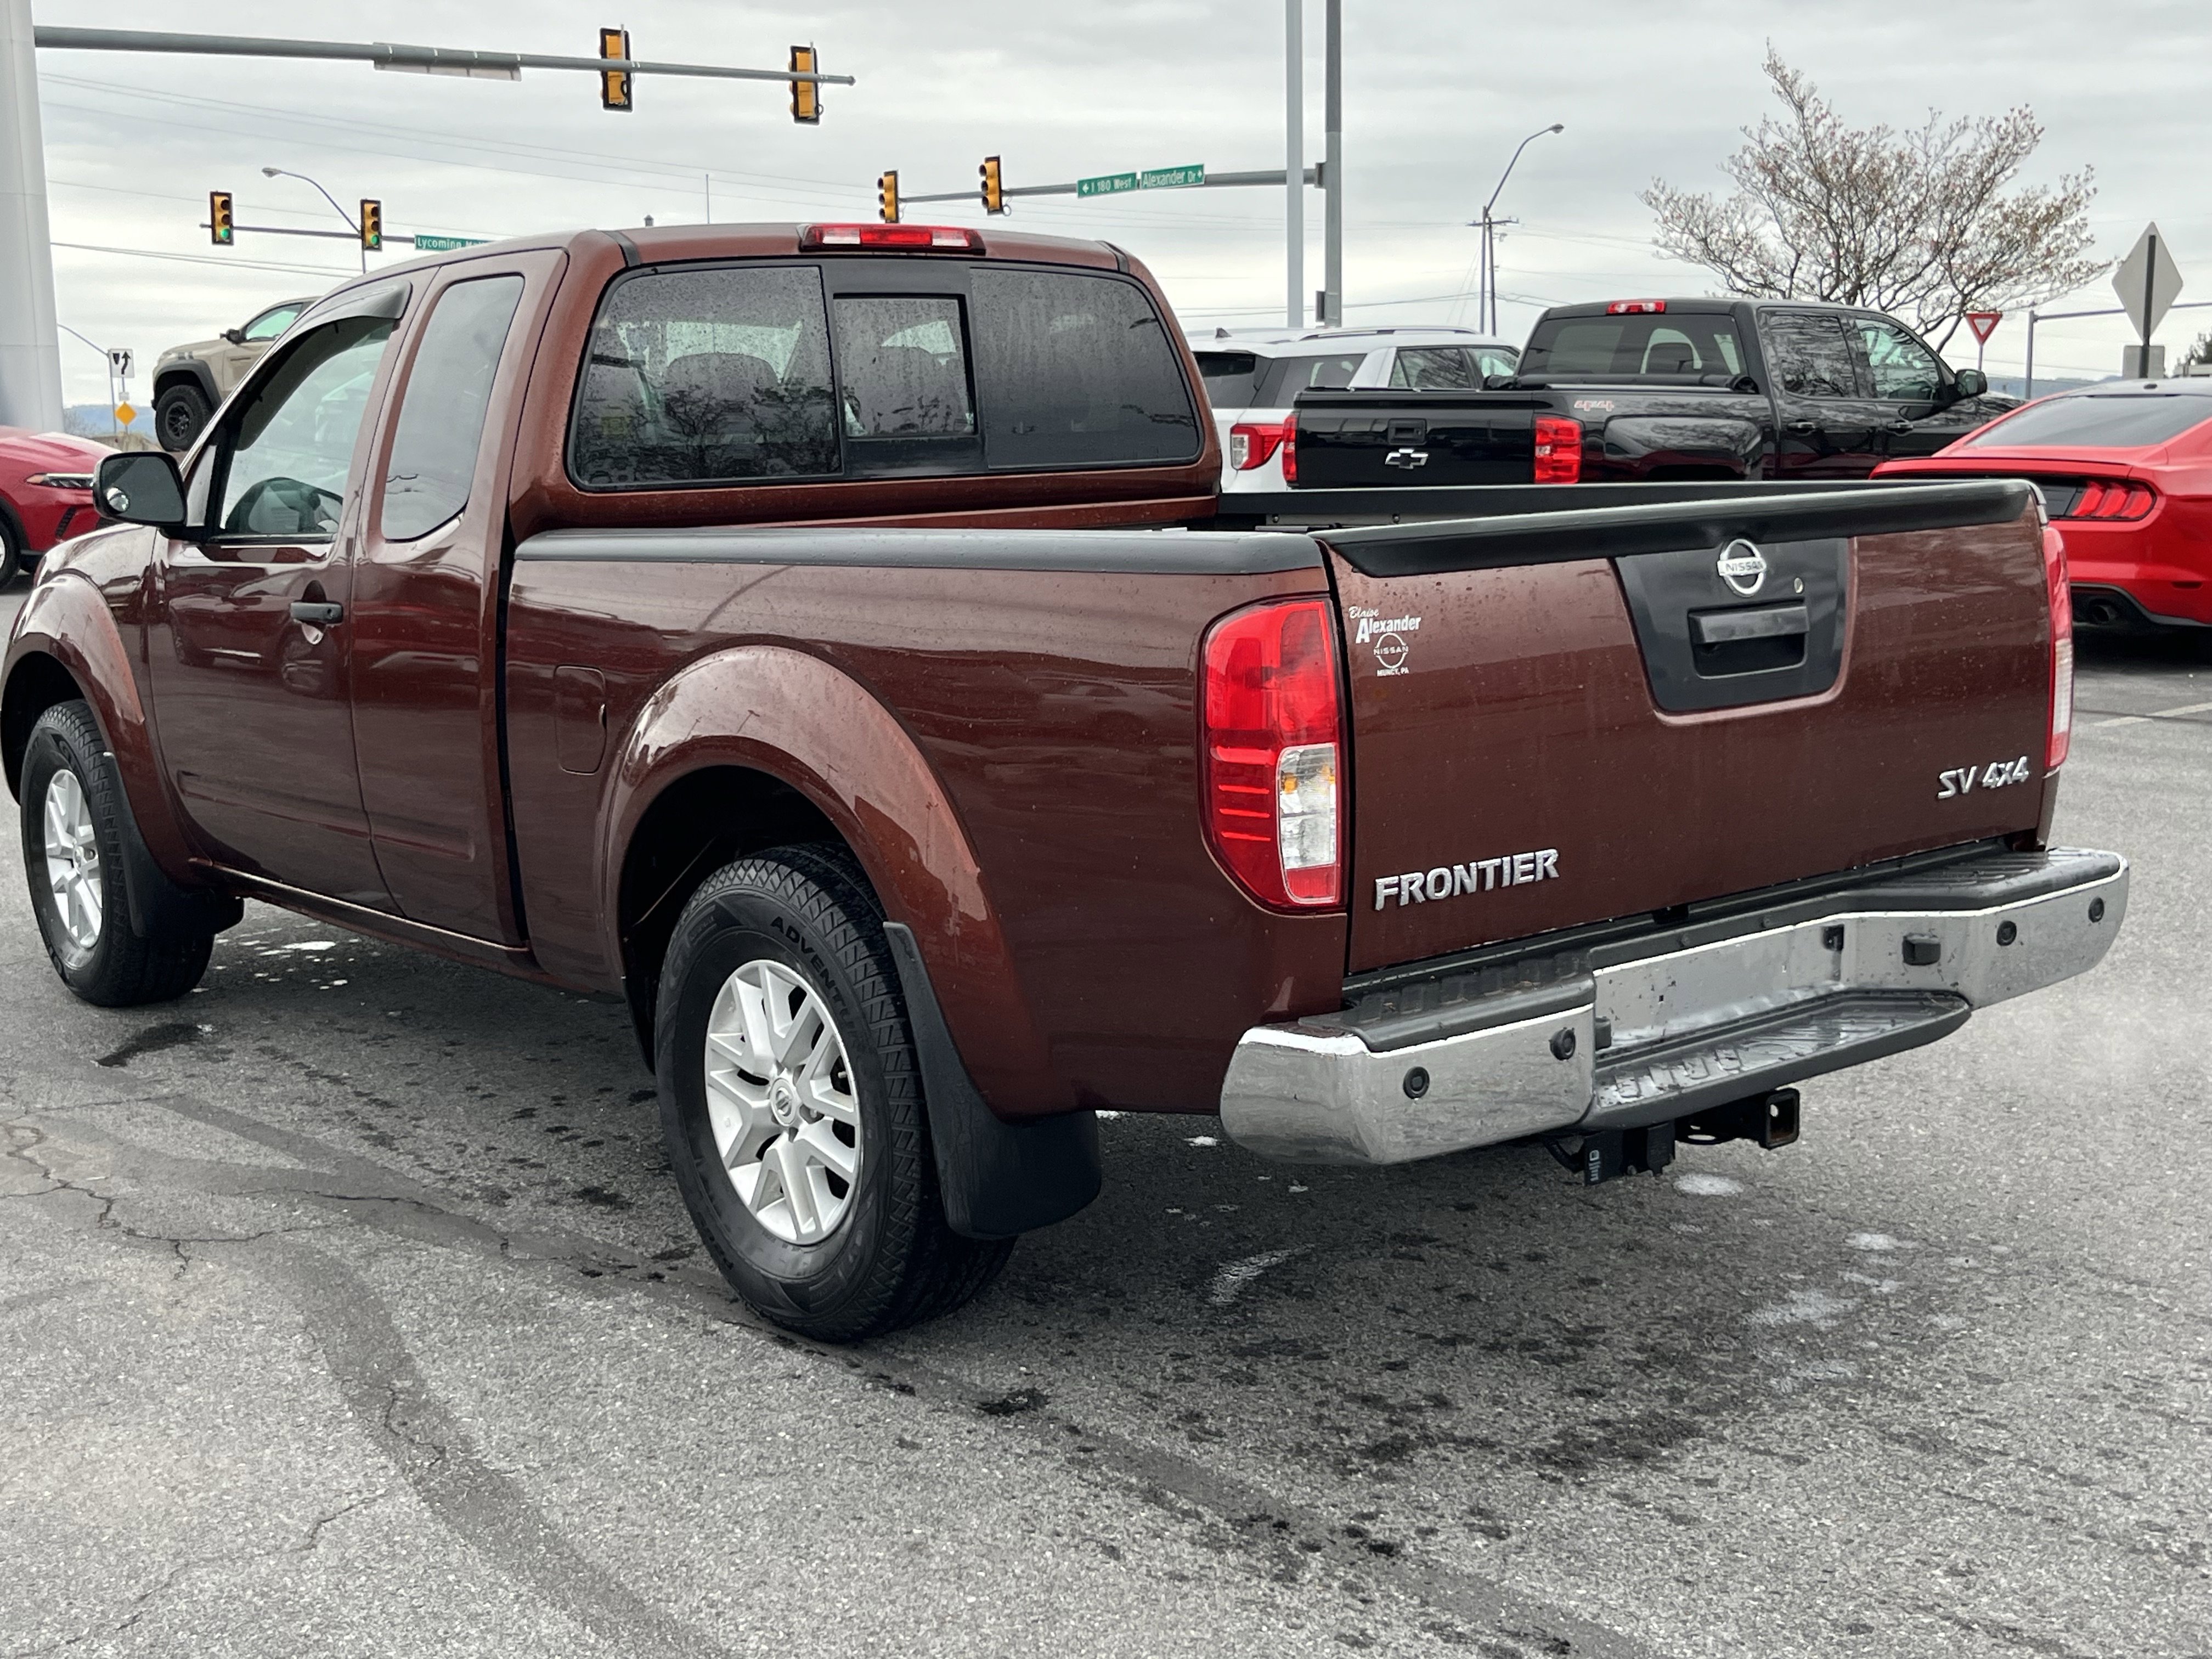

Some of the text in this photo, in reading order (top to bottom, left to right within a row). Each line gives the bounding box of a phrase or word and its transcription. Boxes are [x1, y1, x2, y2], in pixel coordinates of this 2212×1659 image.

[1098, 179, 1111, 192] 180
[1114, 177, 1131, 189] West
[1143, 170, 1195, 187] Alexander Dr
[1725, 561, 1763, 572] NISSAN
[1348, 606, 1379, 619] Blaise
[1356, 614, 1421, 644] Alexander
[1374, 646, 1409, 655] NISSAN
[1938, 766, 1977, 799] SV
[1375, 848, 1559, 911] FRONTIER
[771, 916, 864, 1049] ADVENTU
